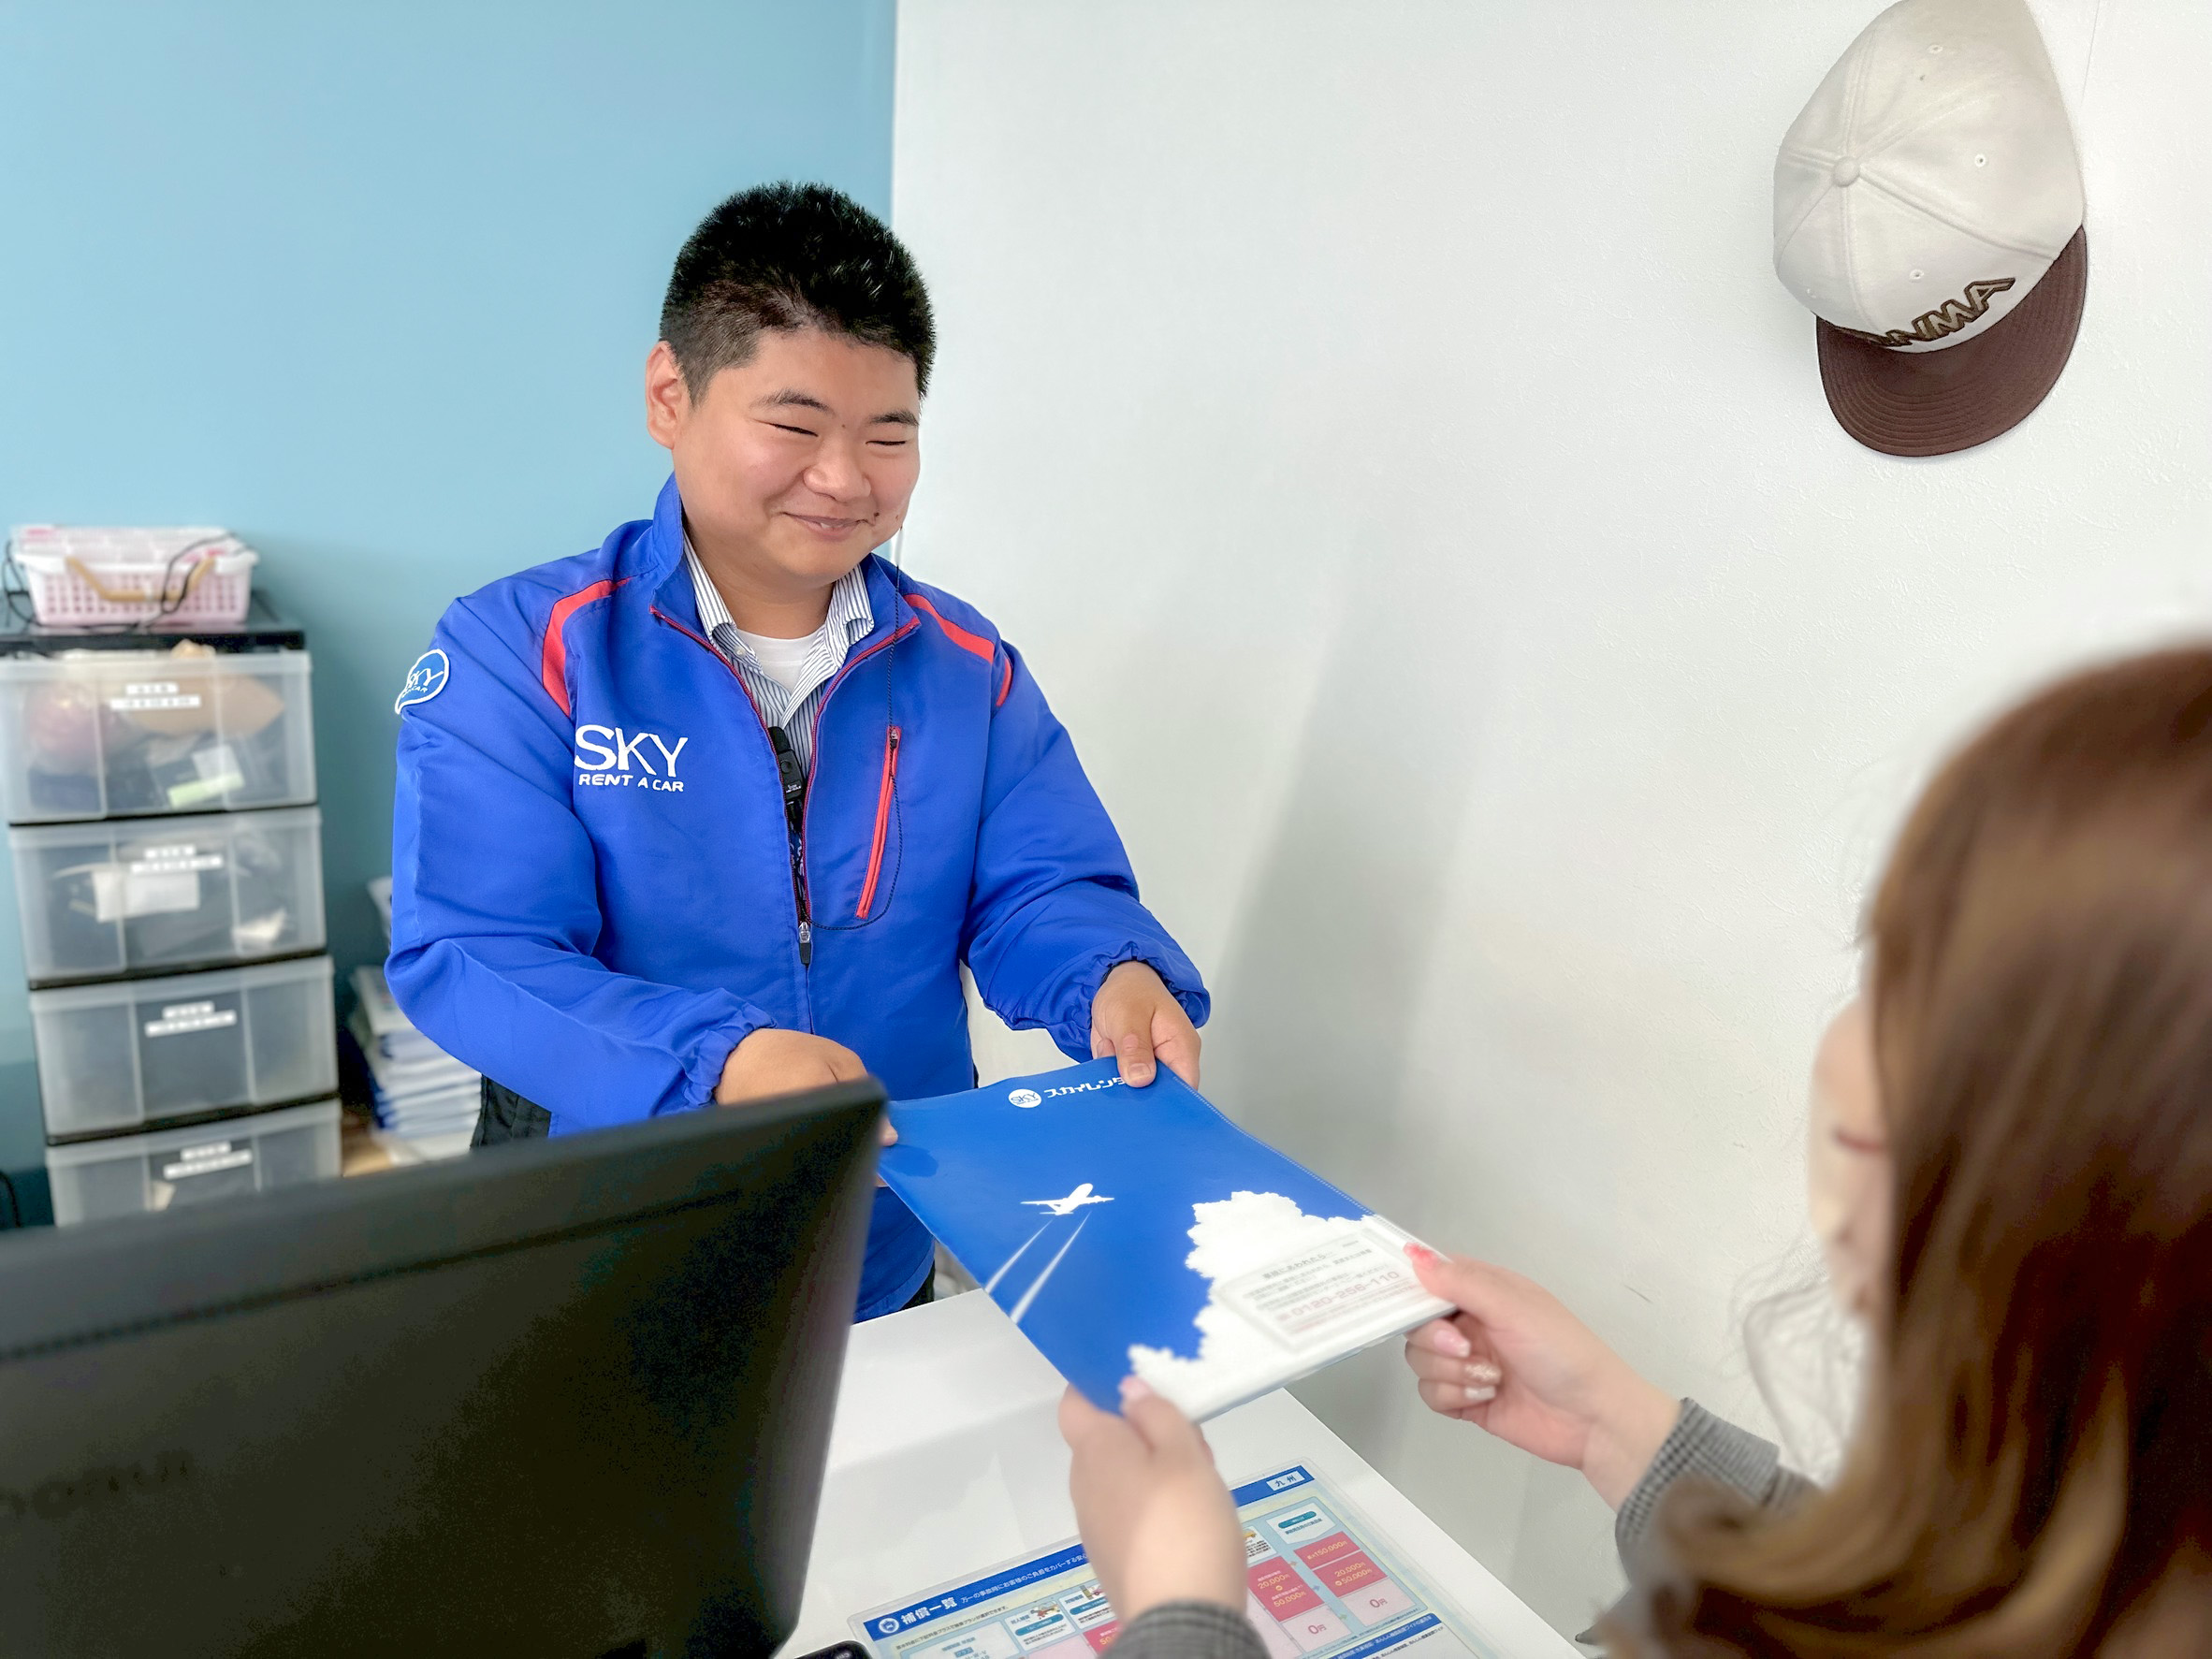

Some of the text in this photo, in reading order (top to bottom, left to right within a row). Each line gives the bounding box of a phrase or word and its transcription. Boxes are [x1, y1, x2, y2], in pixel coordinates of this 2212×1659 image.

[575, 724, 688, 778] SKY
[578, 774, 684, 793] RENT A CAR
[900, 1597, 958, 1625] 補償一覧
